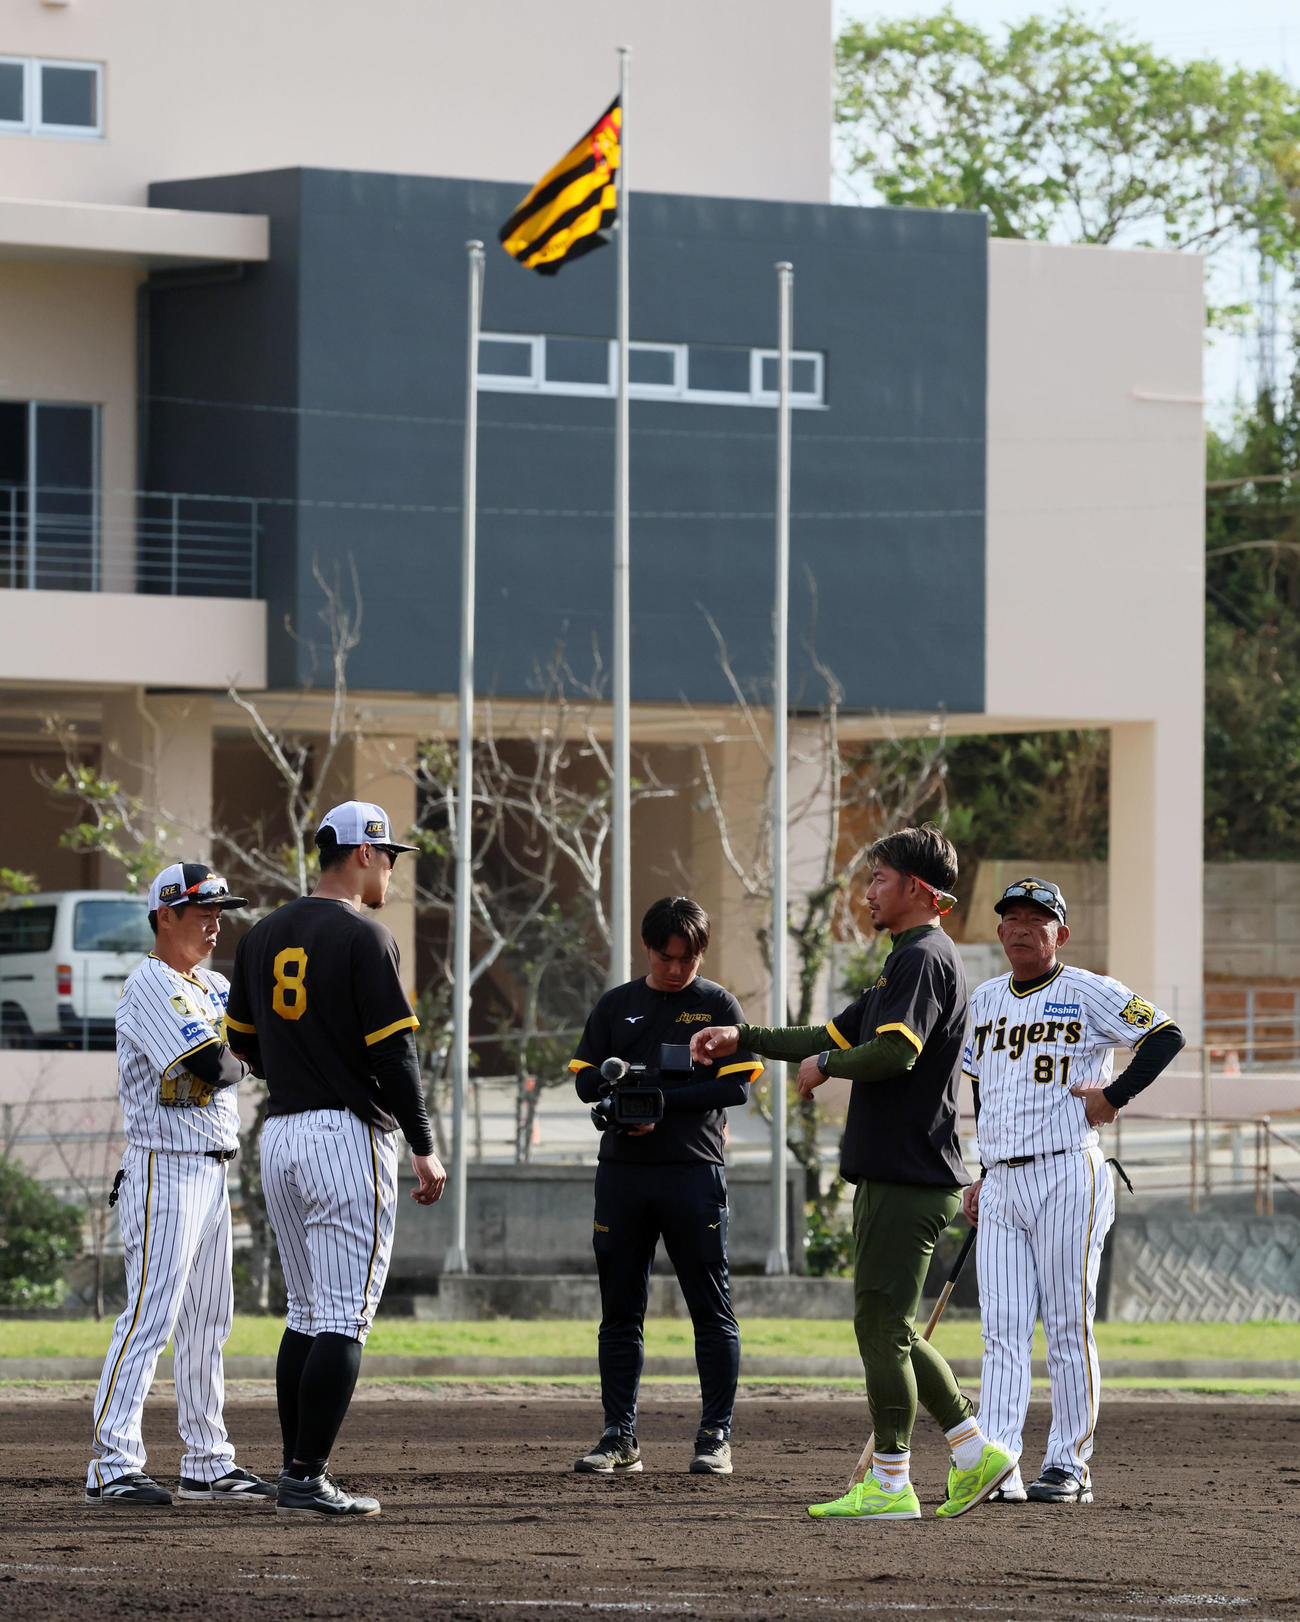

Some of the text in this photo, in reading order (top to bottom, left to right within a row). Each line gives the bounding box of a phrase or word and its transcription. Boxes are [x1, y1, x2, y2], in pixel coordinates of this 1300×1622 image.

[273, 947, 308, 1020] 8
[1045, 1003, 1078, 1015] Joshin
[974, 1017, 1082, 1061] Tigers
[1034, 1054, 1071, 1086] 81
